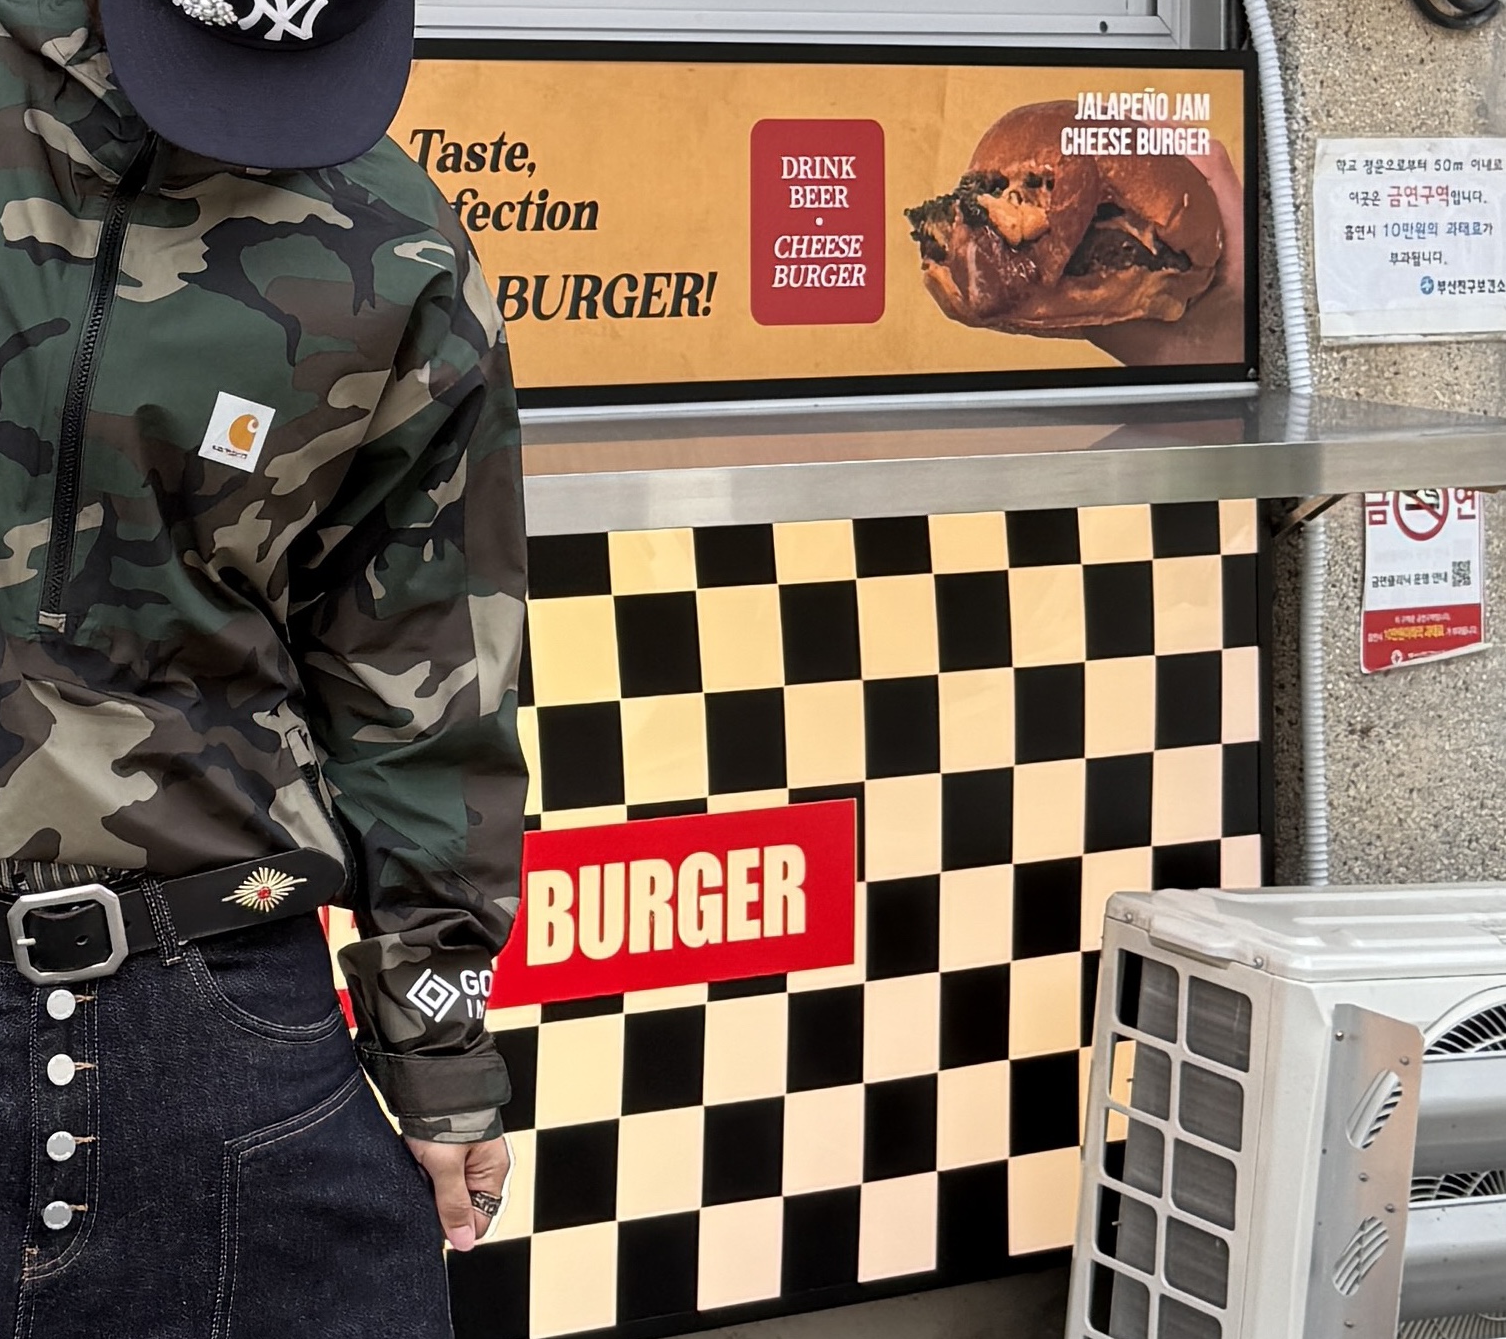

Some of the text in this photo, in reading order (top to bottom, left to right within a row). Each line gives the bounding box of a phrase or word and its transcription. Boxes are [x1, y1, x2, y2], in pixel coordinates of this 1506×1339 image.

[1075, 88, 1210, 120] JALAPEÑO JAM
[409, 129, 536, 178] Taste,
[1061, 128, 1210, 155] CHEESE BURGER
[781, 156, 856, 180] DRINK
[1434, 159, 1463, 171] 50m
[789, 186, 849, 209] BEER
[1383, 223, 1438, 239] 10만원의
[774, 235, 863, 259] CHEESE
[772, 264, 866, 288] BURGER
[497, 271, 718, 321] BURGER!
[527, 844, 806, 966] BURGER
